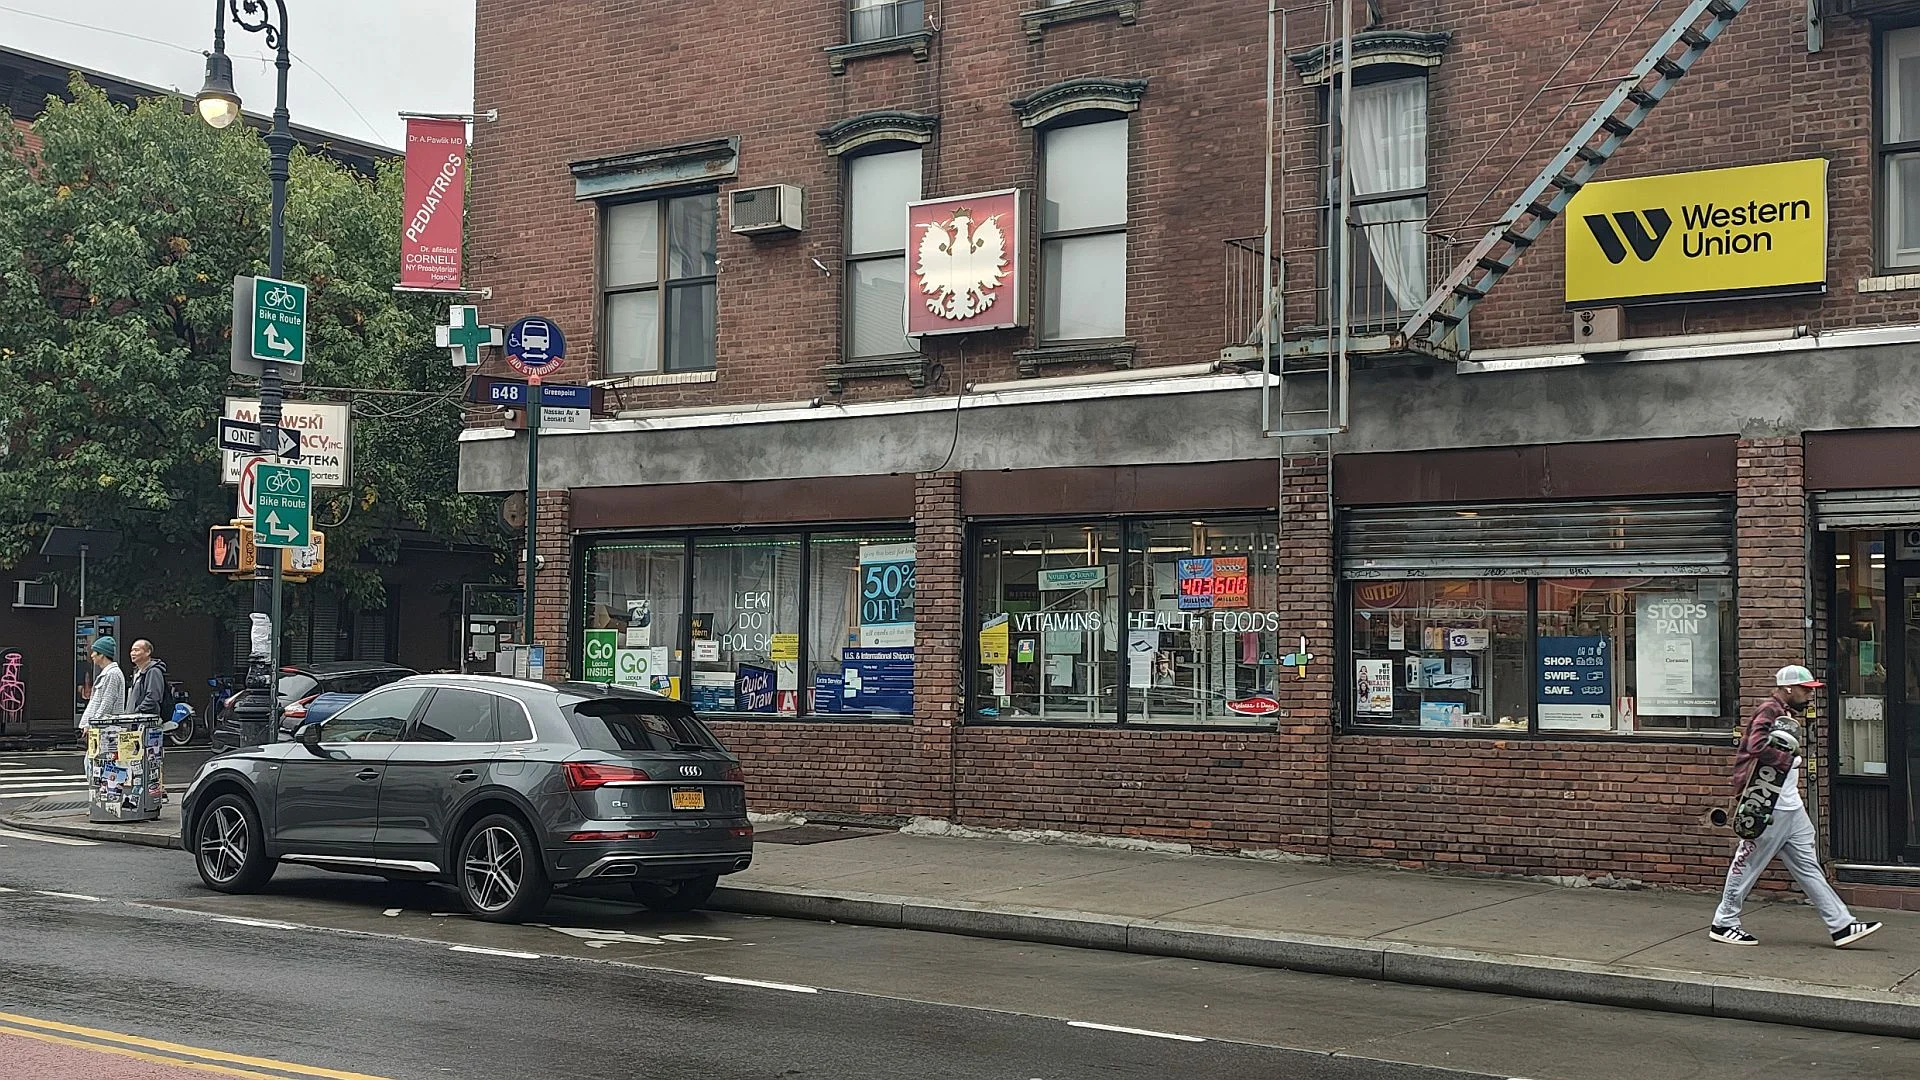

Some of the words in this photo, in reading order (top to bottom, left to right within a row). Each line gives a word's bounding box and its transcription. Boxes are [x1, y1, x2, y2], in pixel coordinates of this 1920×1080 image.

[405, 153, 462, 243] PEDIATRICS
[1681, 199, 1811, 231] Western
[1682, 231, 1772, 258] Union
[406, 254, 457, 265] CORNELL
[259, 310, 277, 321] Bike
[280, 313, 302, 325] Route
[510, 358, 522, 370] NO
[522, 359, 560, 376] STANDING
[492, 386, 518, 400] B48
[544, 388, 576, 397] Greenpoint
[231, 430, 255, 444] ONE
[259, 495, 279, 507] Bike
[281, 497, 306, 509] Route
[863, 564, 916, 599] 50%
[1182, 577, 1213, 596] 403
[863, 599, 902, 622] OFF
[1647, 603, 1708, 619] STOPS
[739, 612, 762, 630] DO
[1014, 611, 1101, 632] VITAMINS
[1127, 611, 1203, 631] HEALTH
[1212, 611, 1279, 632] FOODS
[1656, 619, 1699, 634] PAIN
[587, 639, 613, 659] Go
[1455, 637, 1466, 645] C9
[620, 652, 648, 674] Go
[1543, 657, 1574, 665] SHOP.
[587, 667, 614, 677] INSIDE
[1544, 671, 1580, 680] SWIPE.
[741, 671, 769, 694] Quick
[1544, 686, 1574, 695] SAVE.
[747, 691, 773, 710] Draw
